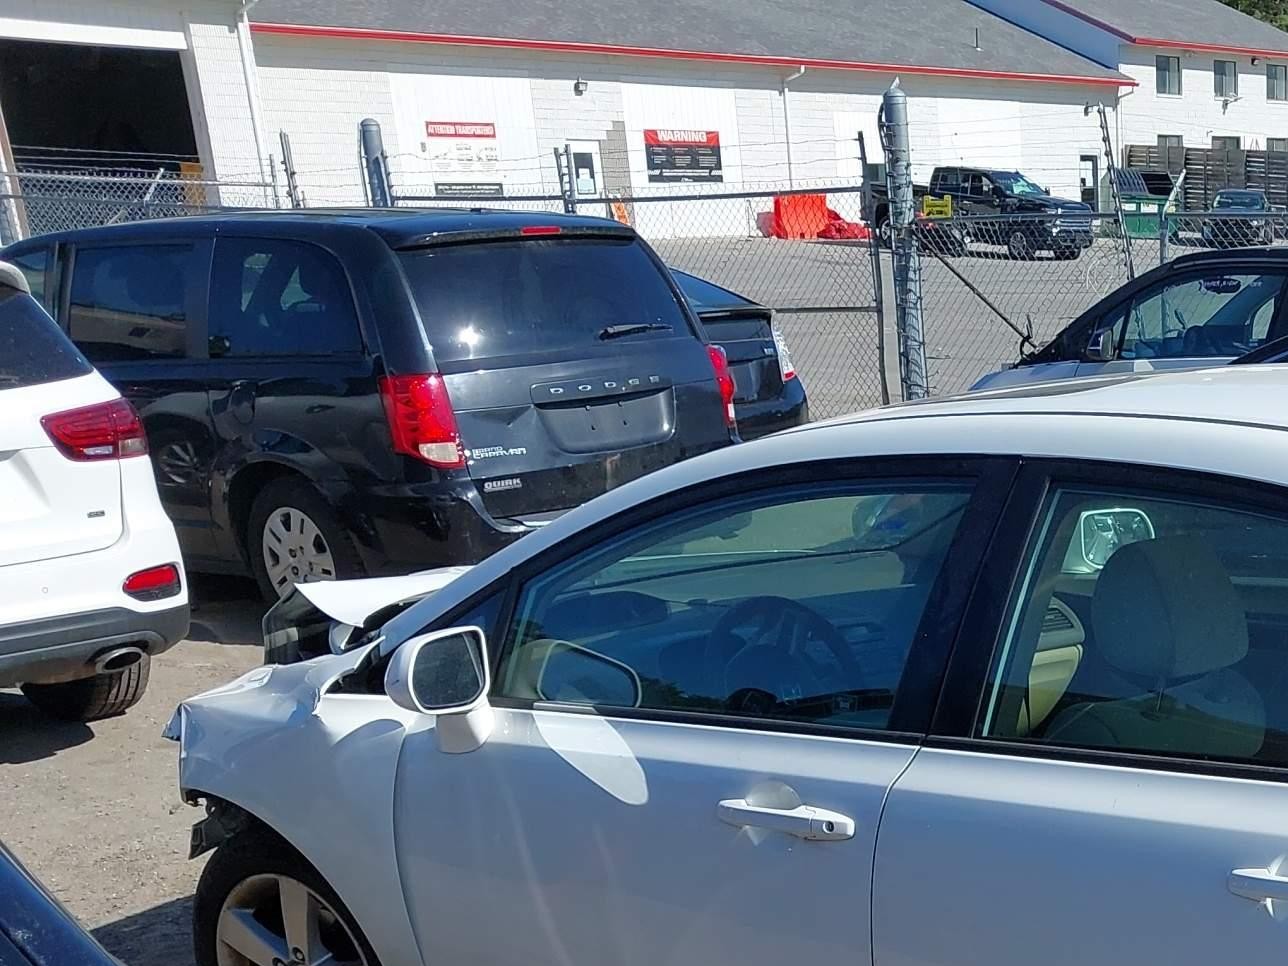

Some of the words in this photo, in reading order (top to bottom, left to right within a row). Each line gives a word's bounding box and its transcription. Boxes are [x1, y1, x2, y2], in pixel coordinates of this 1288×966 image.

[656, 130, 707, 143] WARNING
[549, 375, 660, 395] DODGE
[484, 478, 521, 489] QUIRK
